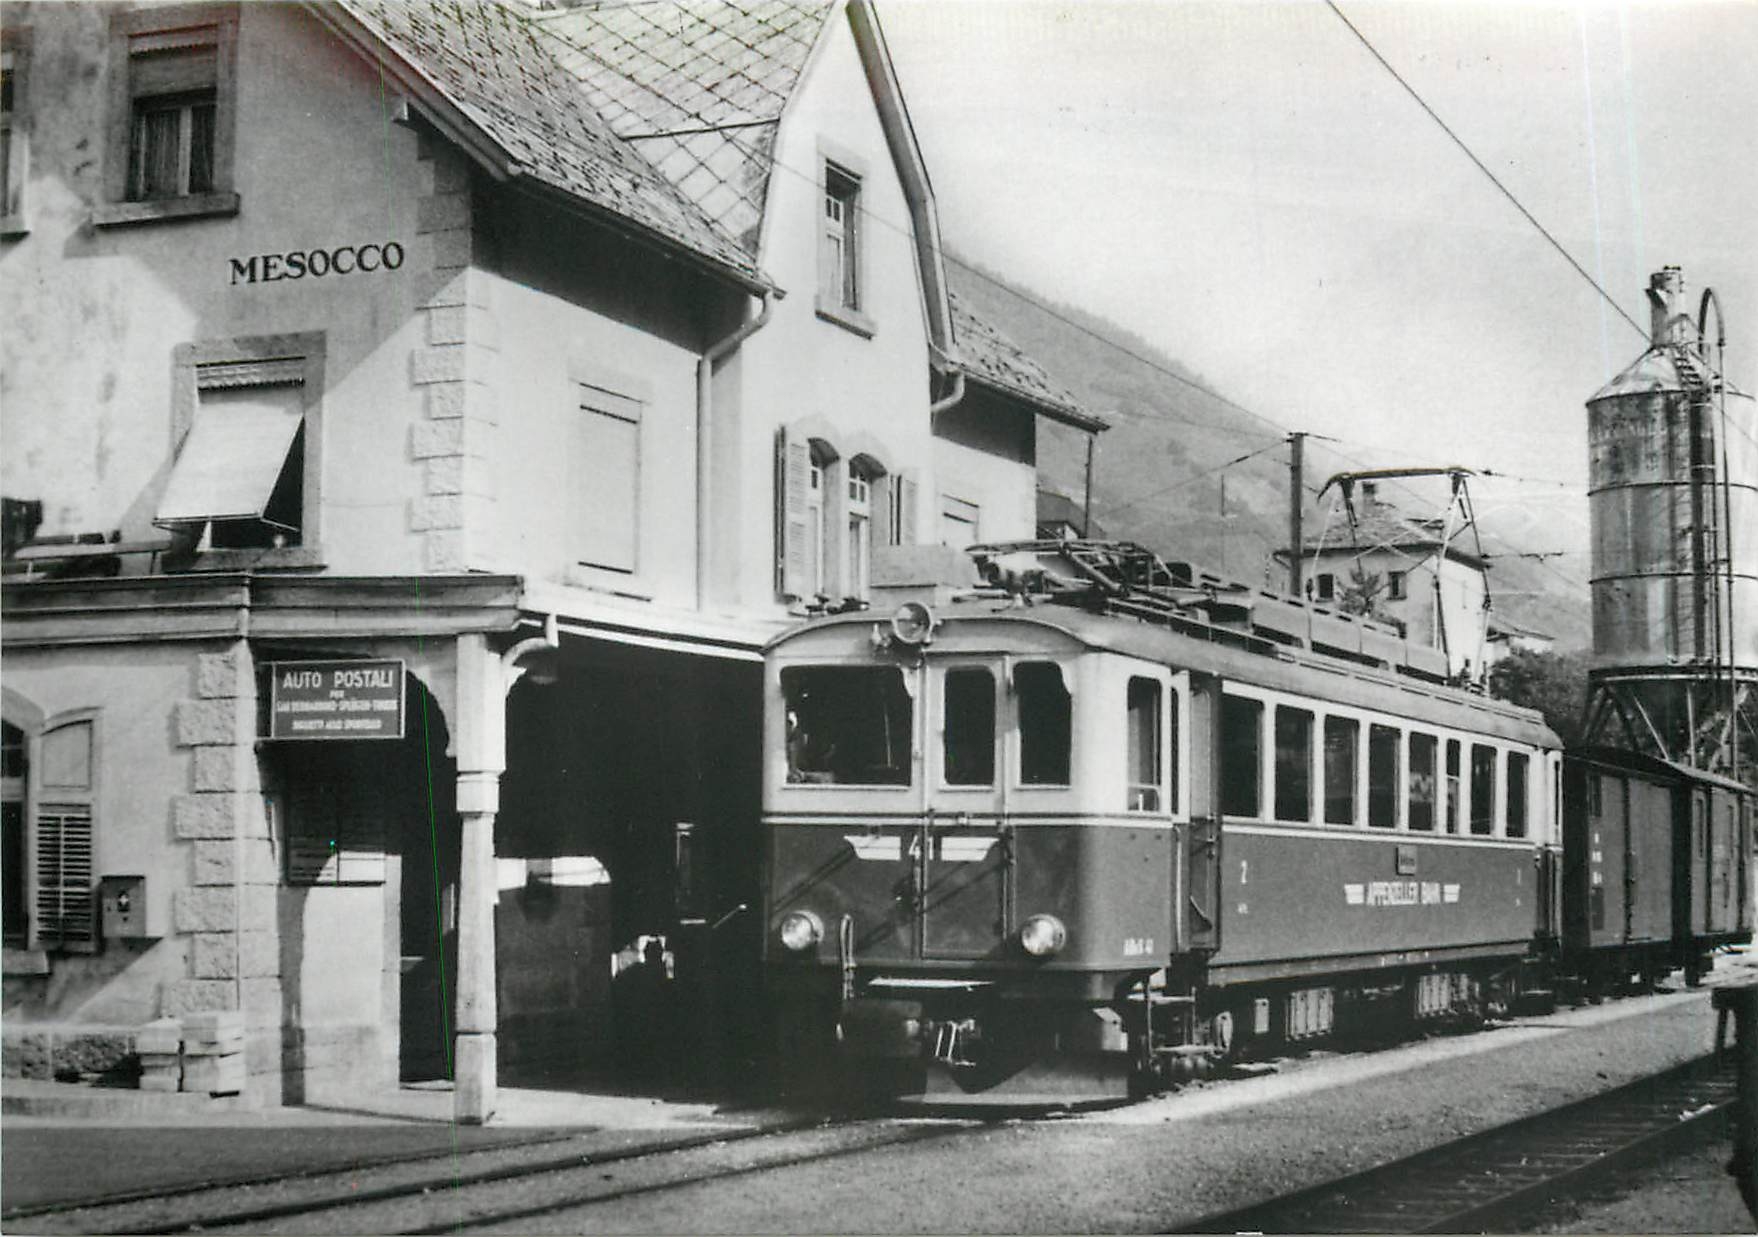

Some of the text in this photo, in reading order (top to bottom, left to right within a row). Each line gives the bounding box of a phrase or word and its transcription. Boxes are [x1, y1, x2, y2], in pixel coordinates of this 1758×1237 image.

[229, 242, 404, 285] MESOCCO
[283, 670, 393, 688] AUTO POSTALI
